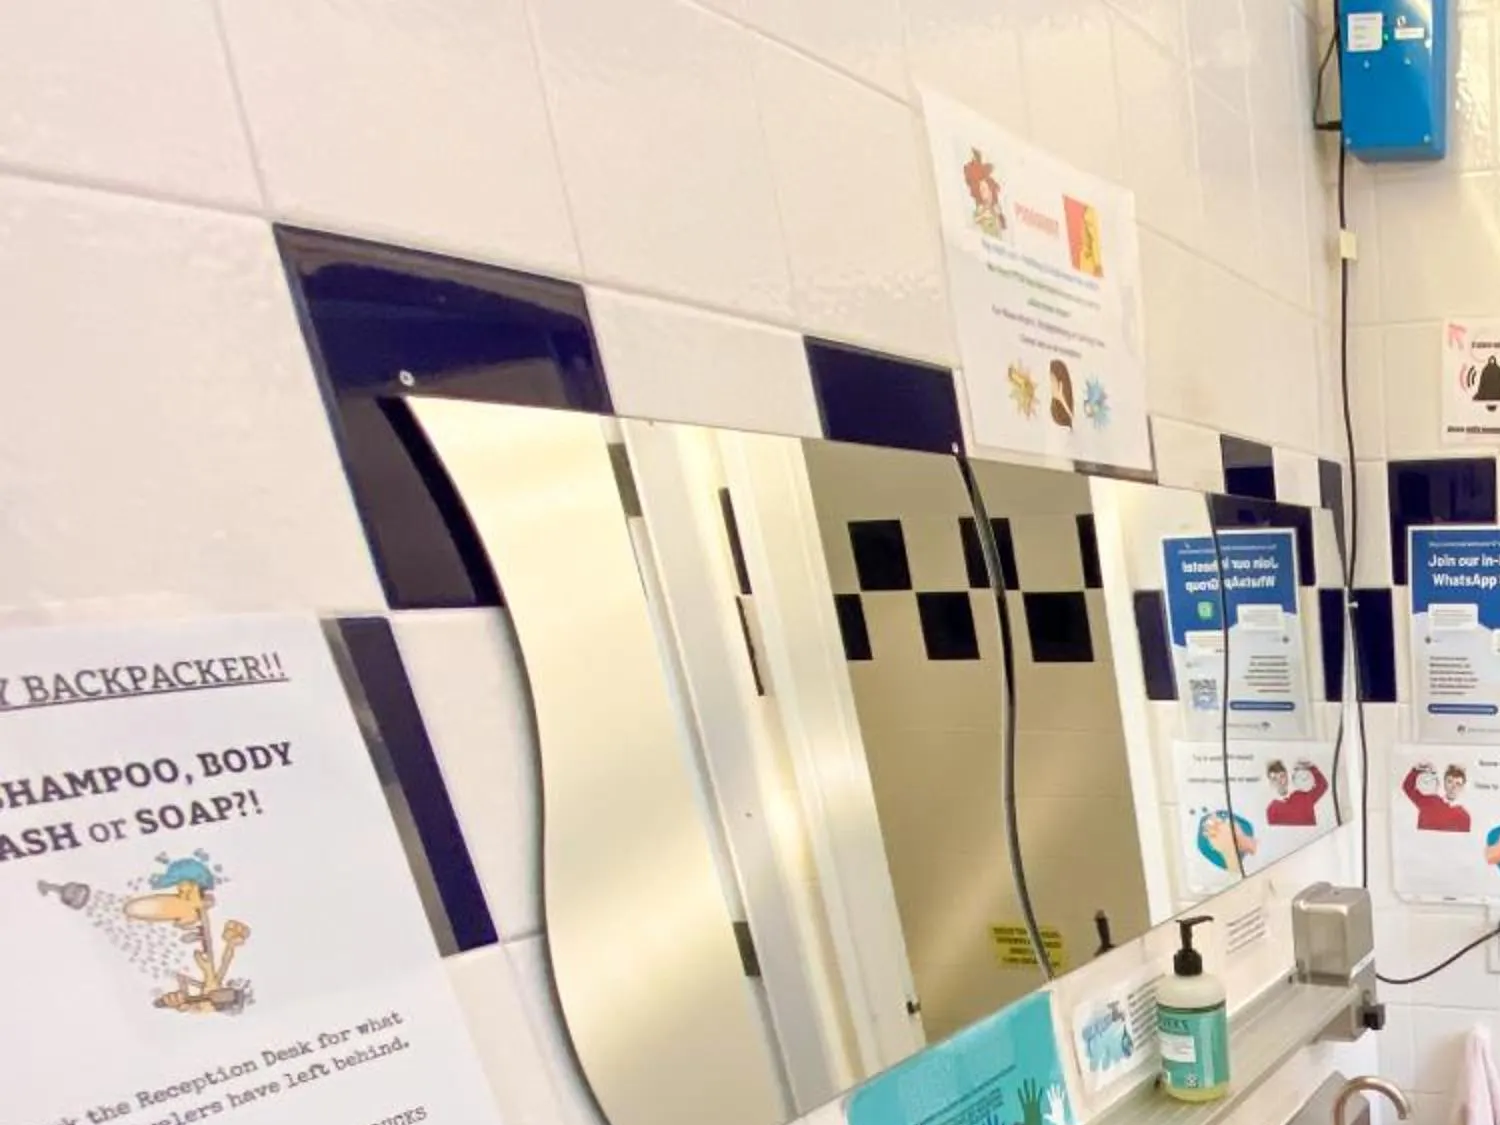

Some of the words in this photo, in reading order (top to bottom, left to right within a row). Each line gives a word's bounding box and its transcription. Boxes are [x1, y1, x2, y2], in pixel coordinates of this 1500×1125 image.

[1428, 553, 1456, 567] Join
[1458, 557, 1480, 567] our
[1432, 573, 1497, 590] WhatsApp
[22, 652, 285, 703] BACKPACKER!!
[196, 742, 293, 778] BODY
[88, 818, 127, 844] or
[135, 790, 263, 835] SOAP?!
[86, 1101, 131, 1125] the
[135, 1060, 259, 1109] Reception
[261, 1041, 314, 1067] Desk
[317, 1027, 352, 1050] for
[356, 1011, 404, 1036] what
[226, 1079, 281, 1109] have
[284, 1062, 330, 1089] left
[332, 1036, 410, 1072] behind.
